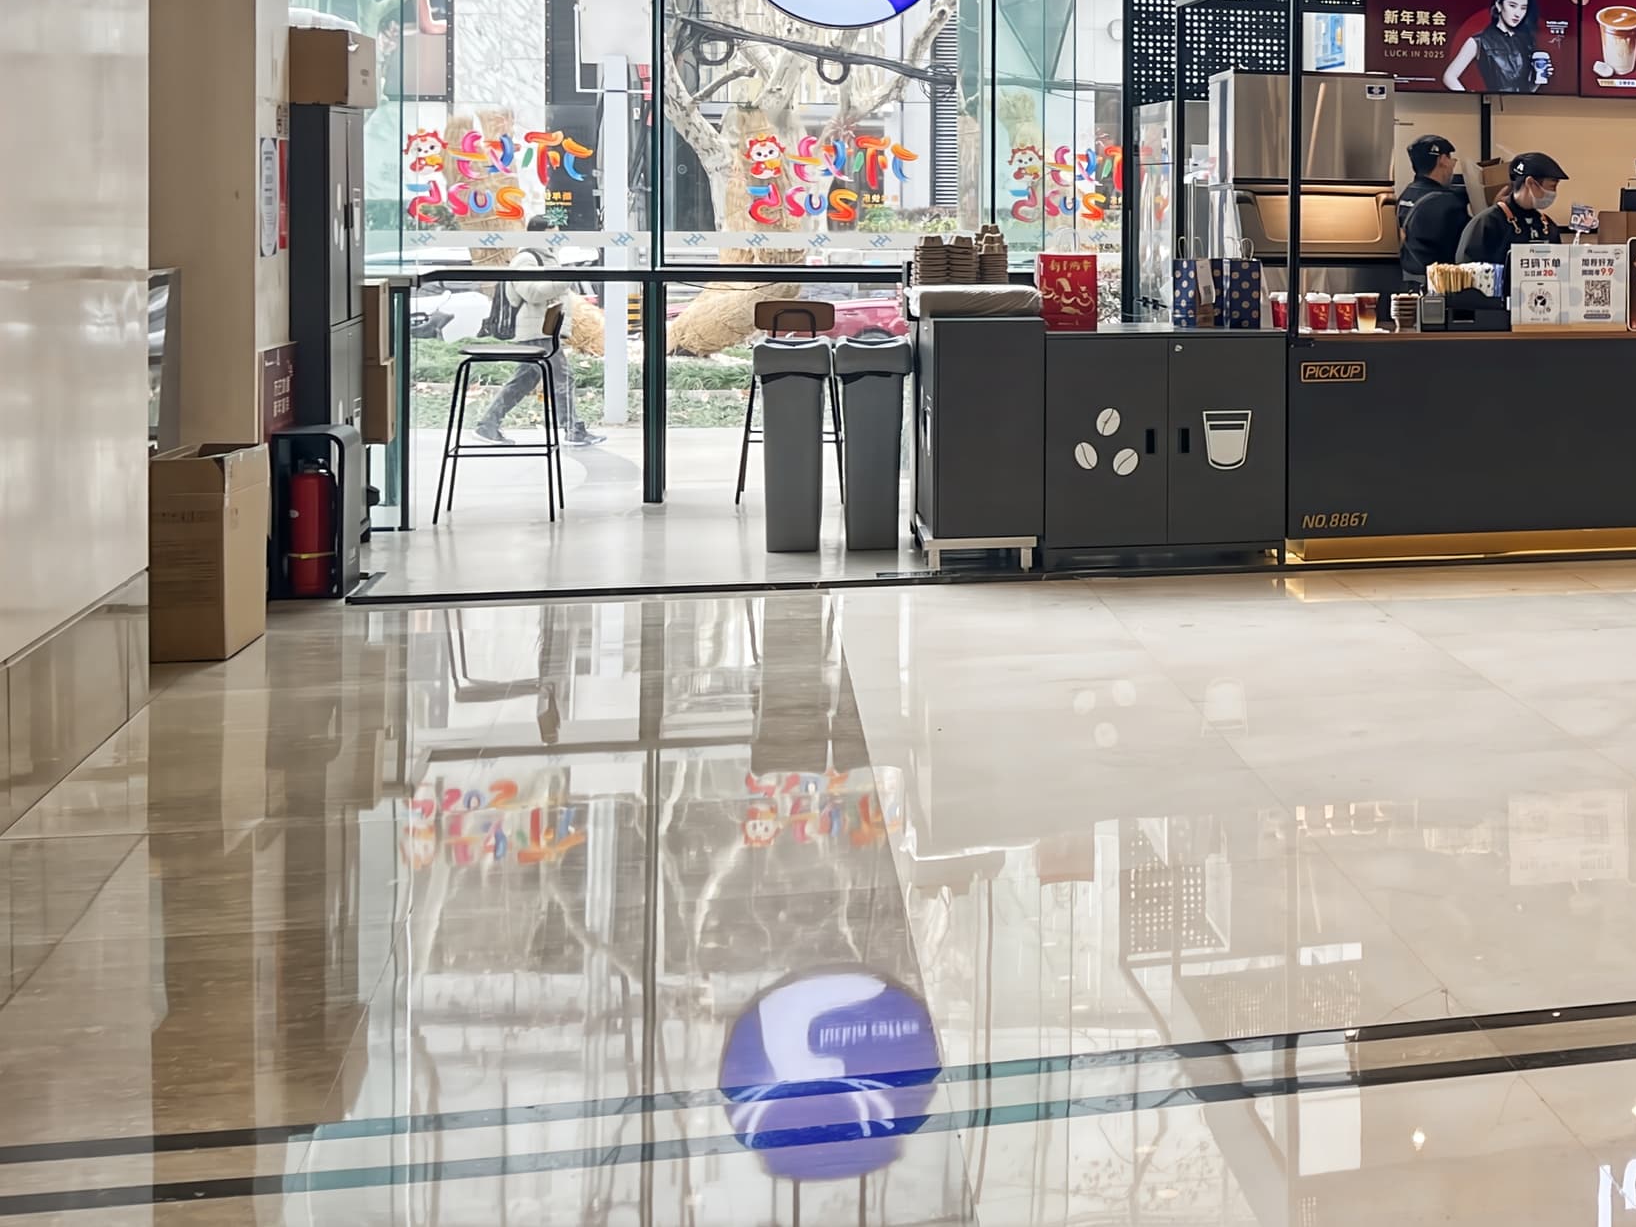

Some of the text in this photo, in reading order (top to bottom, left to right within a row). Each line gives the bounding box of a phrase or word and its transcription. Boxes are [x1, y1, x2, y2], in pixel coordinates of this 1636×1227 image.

[1384, 9, 1447, 26] 新年聚会
[1384, 29, 1447, 46] 瑞气满杯
[1384, 49, 1444, 59] LUCK IN 2025
[1520, 258, 1561, 269] 扫码下单
[1304, 365, 1361, 379] PICKUP
[1302, 512, 1368, 529] NO.8861
